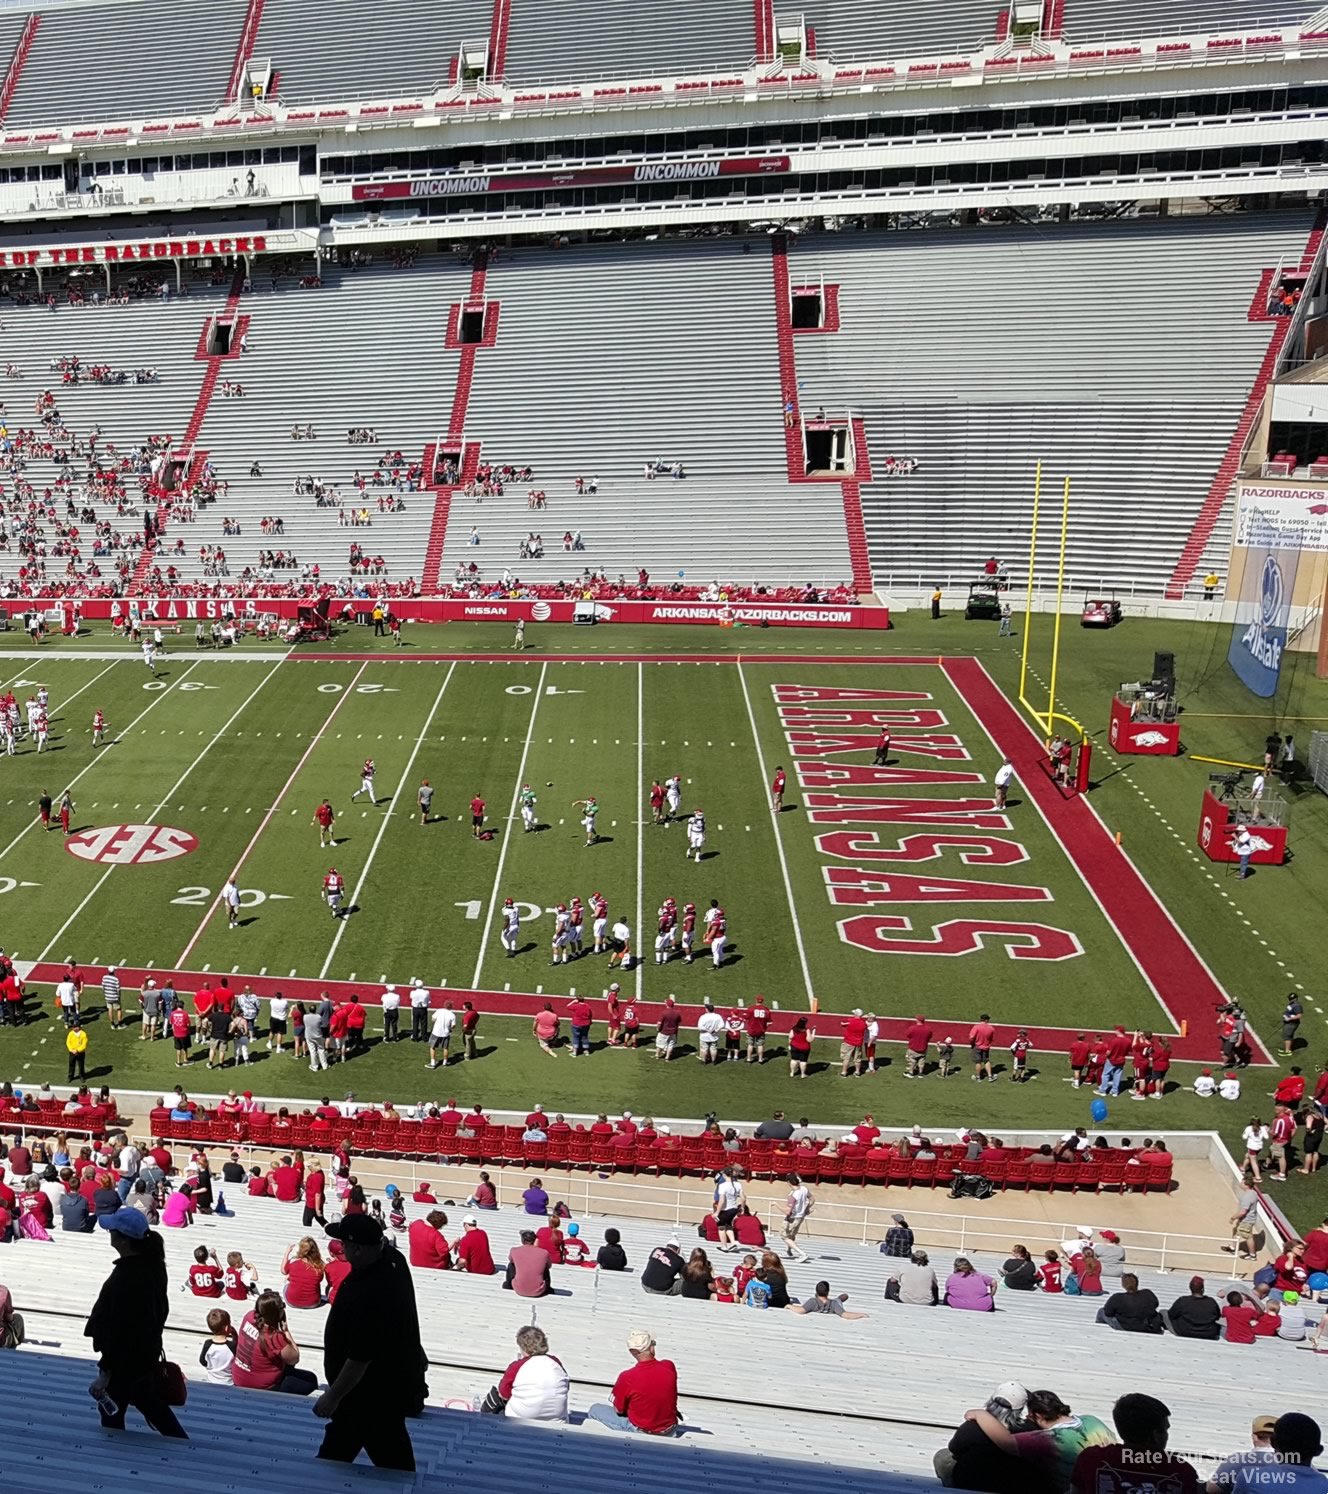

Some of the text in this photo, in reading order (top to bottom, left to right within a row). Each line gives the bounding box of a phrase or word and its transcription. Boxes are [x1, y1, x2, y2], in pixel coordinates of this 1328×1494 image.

[634, 161, 720, 181] UNCOMMON
[409, 177, 491, 196] UNCOMMON
[12, 250, 40, 267] OF
[49, 246, 96, 265] THE
[104, 236, 266, 261] RAZORBACKS
[1241, 488, 1325, 500] RAZORBACKS
[1278, 532, 1295, 540] Game
[1309, 533, 1321, 542] App
[464, 607, 507, 615] NISSAN
[653, 607, 851, 622] ARKANSASAZORBACKS.COM
[1241, 620, 1281, 670] Allstate
[142, 681, 206, 691] 30
[317, 683, 385, 693] 20
[504, 685, 566, 696] 10
[770, 684, 1085, 961] ARKANSAS
[67, 824, 193, 863] SEC
[171, 886, 265, 908] 20
[194, 1272, 213, 1288] 86
[1052, 1273, 1060, 1285] 7
